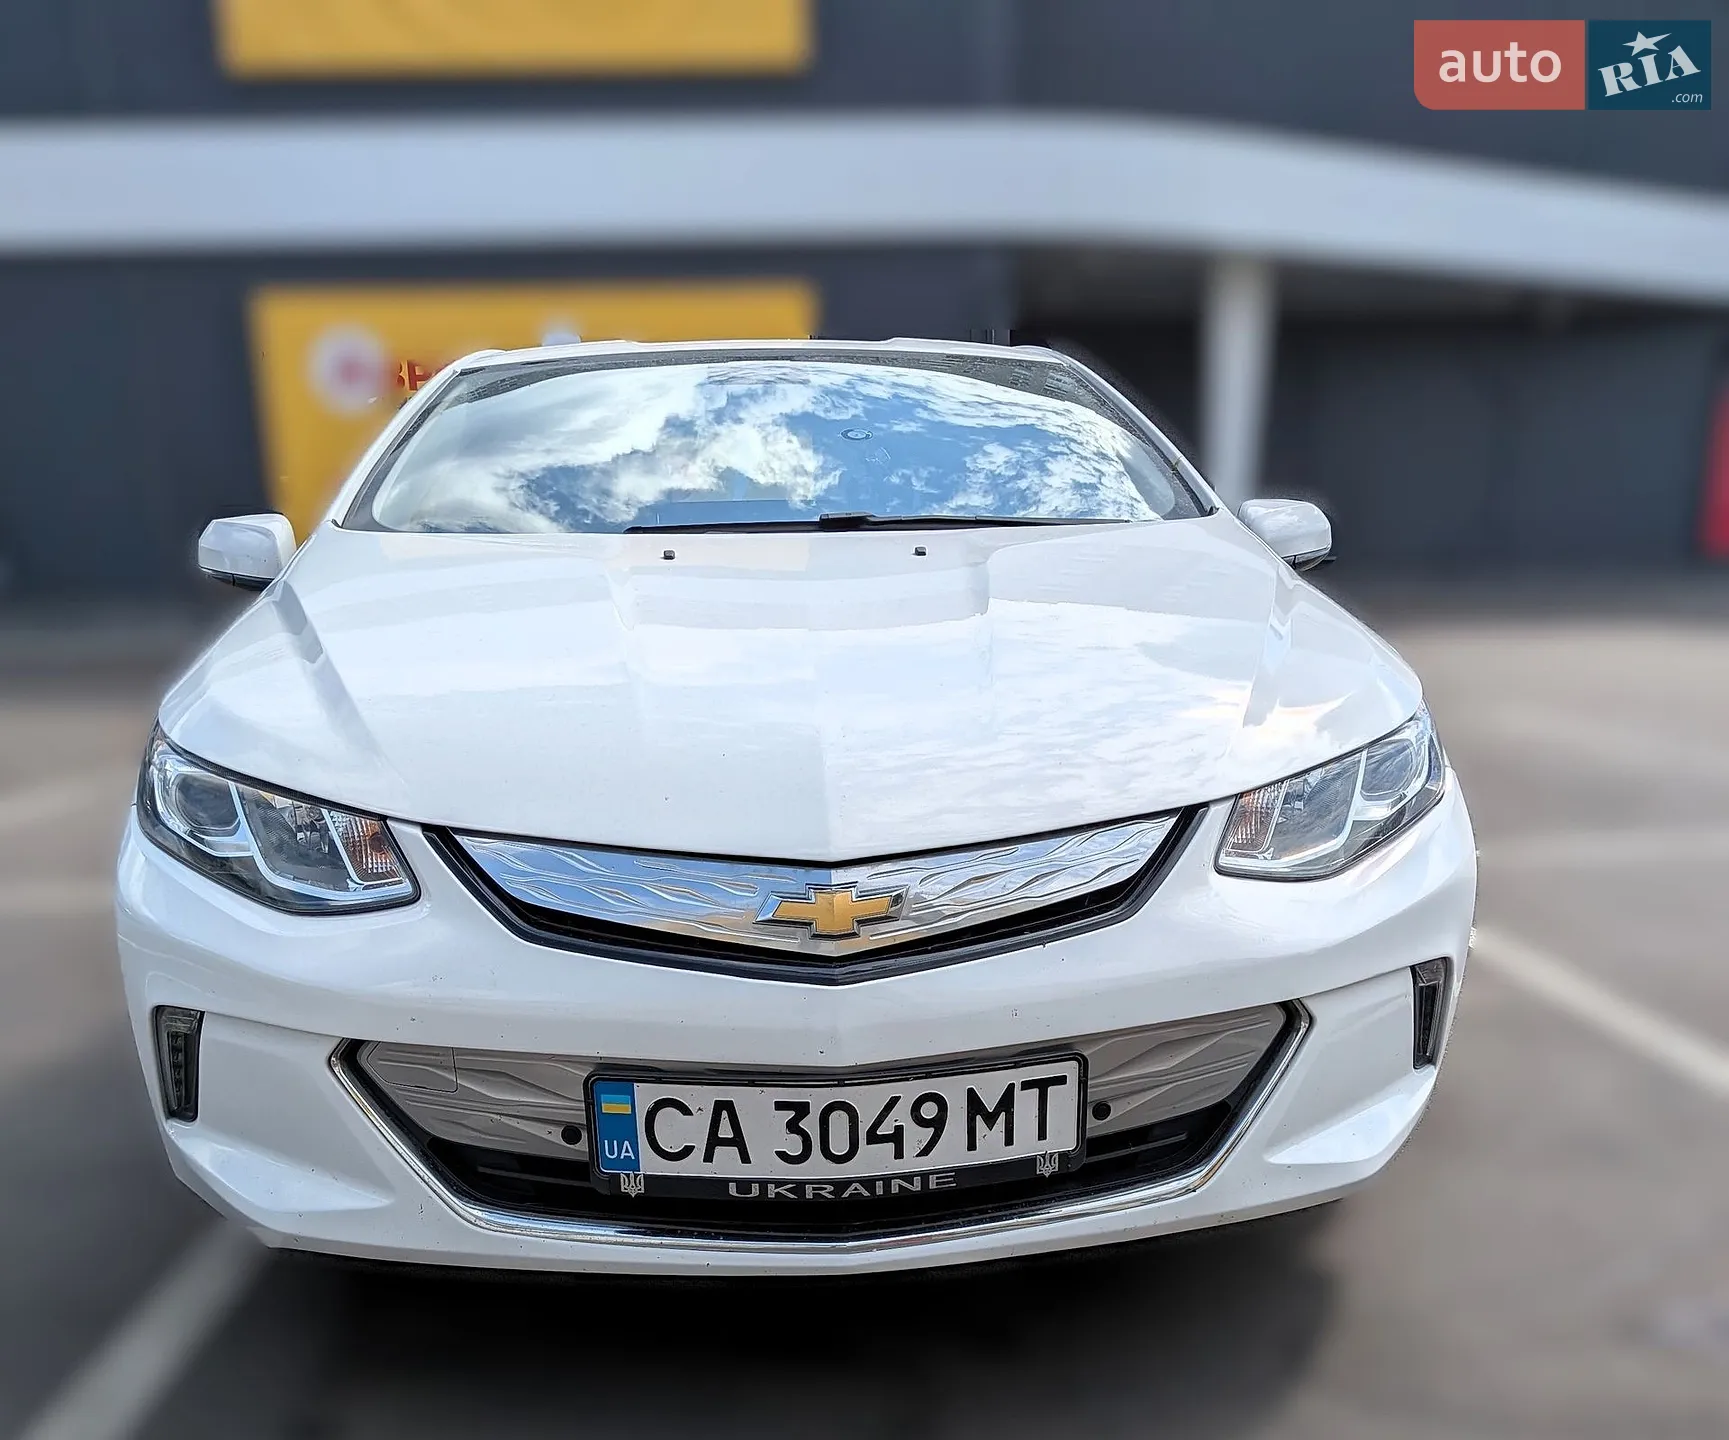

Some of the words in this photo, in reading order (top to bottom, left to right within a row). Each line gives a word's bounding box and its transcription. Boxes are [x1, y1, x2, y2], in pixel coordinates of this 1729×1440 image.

[644, 1096, 752, 1165] CA
[774, 1091, 949, 1165] 3049
[965, 1074, 1068, 1152] MT
[604, 1140, 636, 1160] UA
[728, 1171, 957, 1199] UKRAINE
